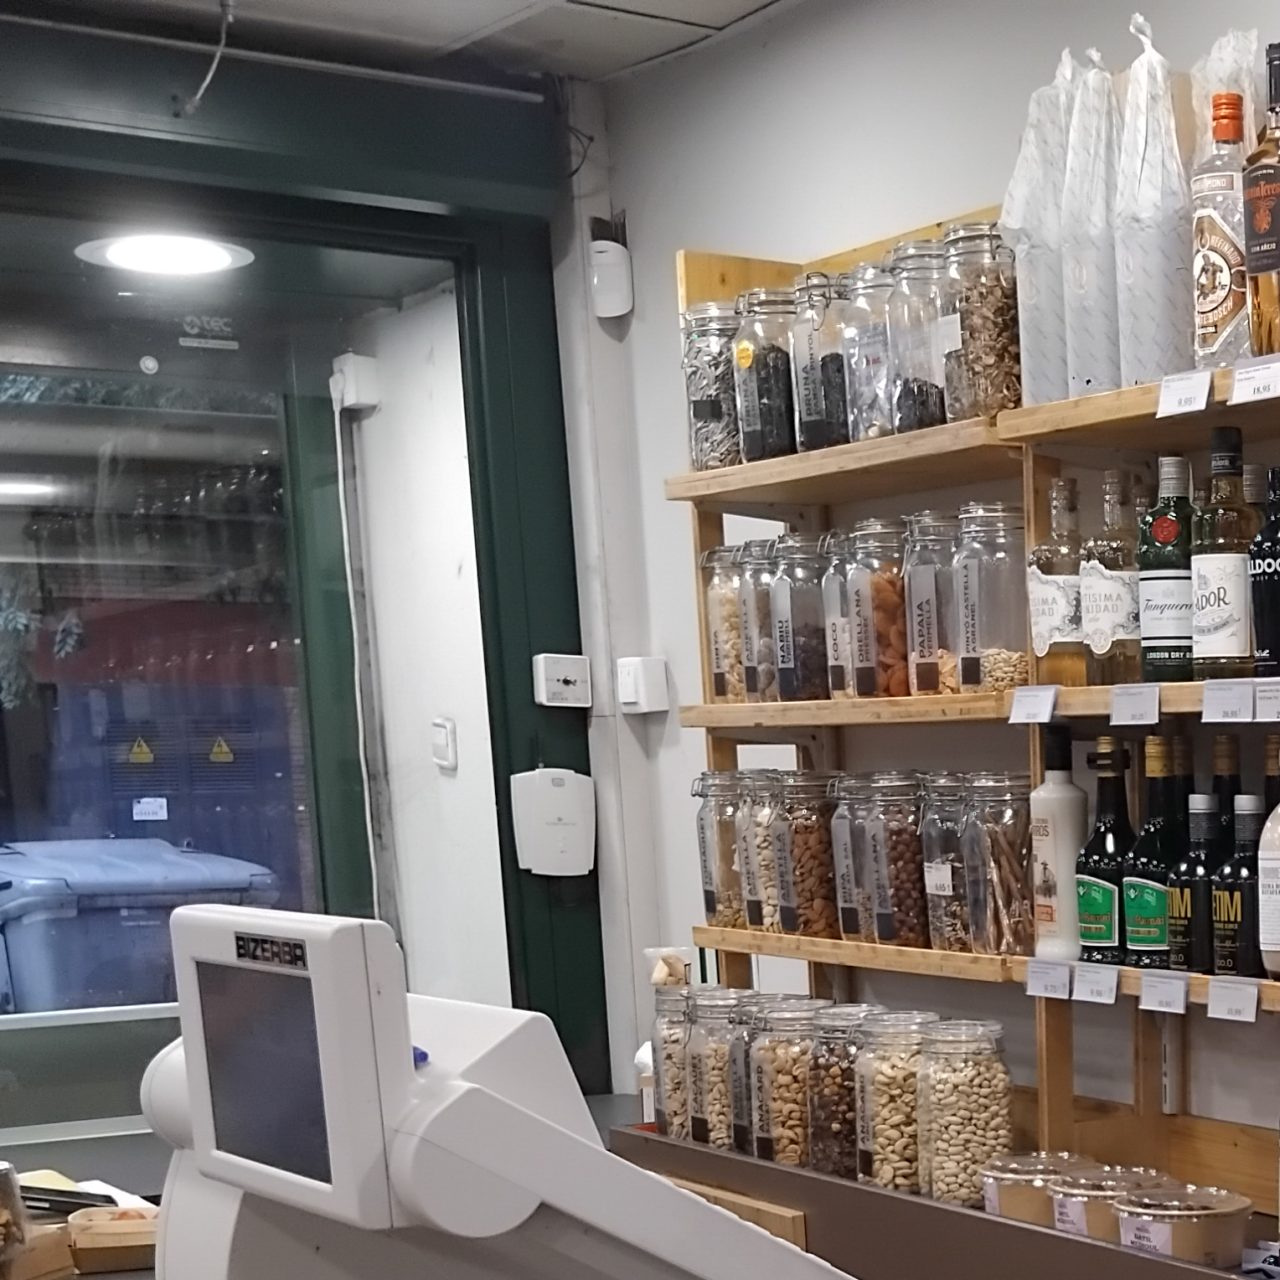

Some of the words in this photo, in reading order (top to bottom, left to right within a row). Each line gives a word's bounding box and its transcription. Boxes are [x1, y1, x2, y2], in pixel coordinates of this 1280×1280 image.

[801, 364, 813, 417] PRUNA
[777, 619, 787, 665] NABIU
[832, 622, 840, 661] COCO
[854, 588, 864, 663] ORELLANA
[916, 600, 927, 659] PAPAIA
[926, 597, 934, 658] VERMELLA
[234, 934, 307, 968] BIZERBA
[756, 1065, 766, 1133] ANACARD
